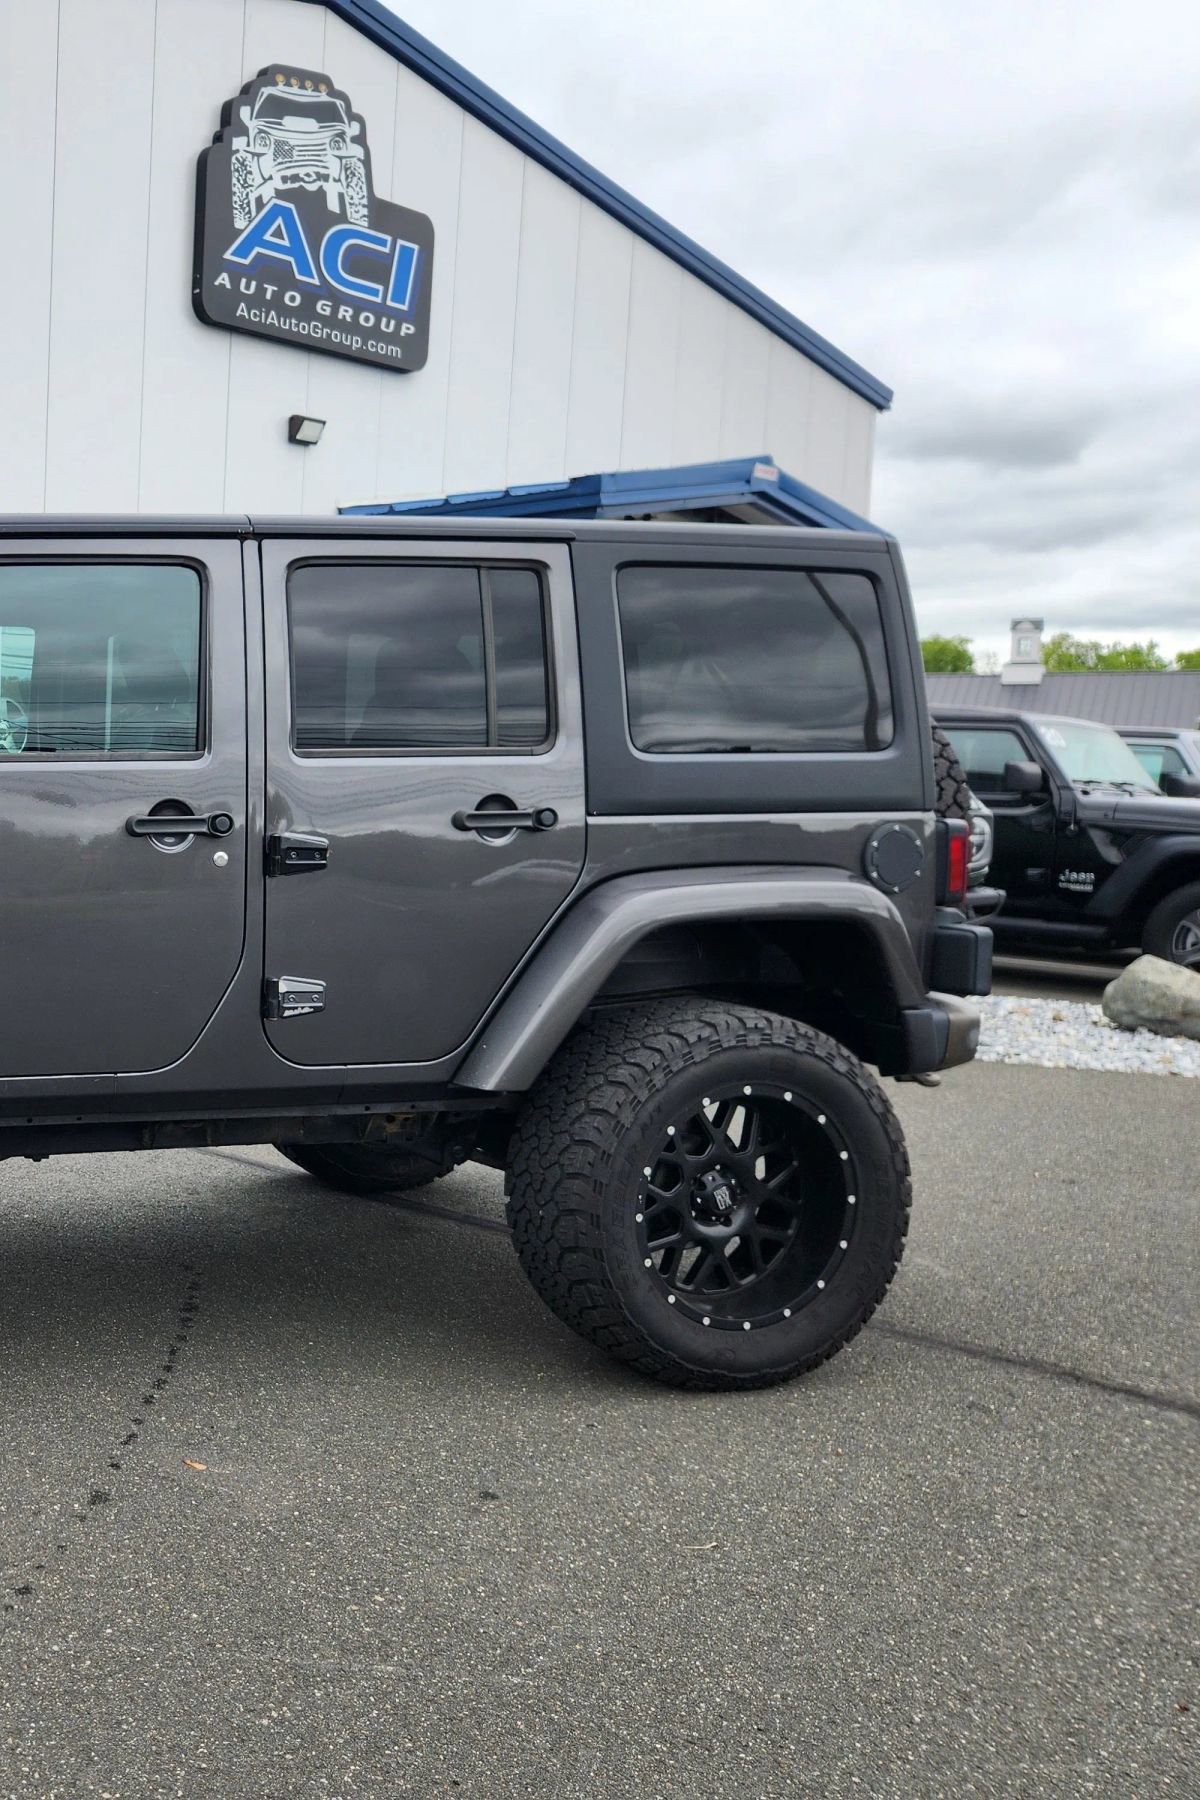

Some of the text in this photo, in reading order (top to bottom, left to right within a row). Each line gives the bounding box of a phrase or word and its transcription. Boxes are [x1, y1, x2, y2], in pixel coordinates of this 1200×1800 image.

[223, 197, 420, 311] ACI
[214, 272, 417, 337] AUTO GROUP
[236, 302, 403, 358] AciAutoGroup.com
